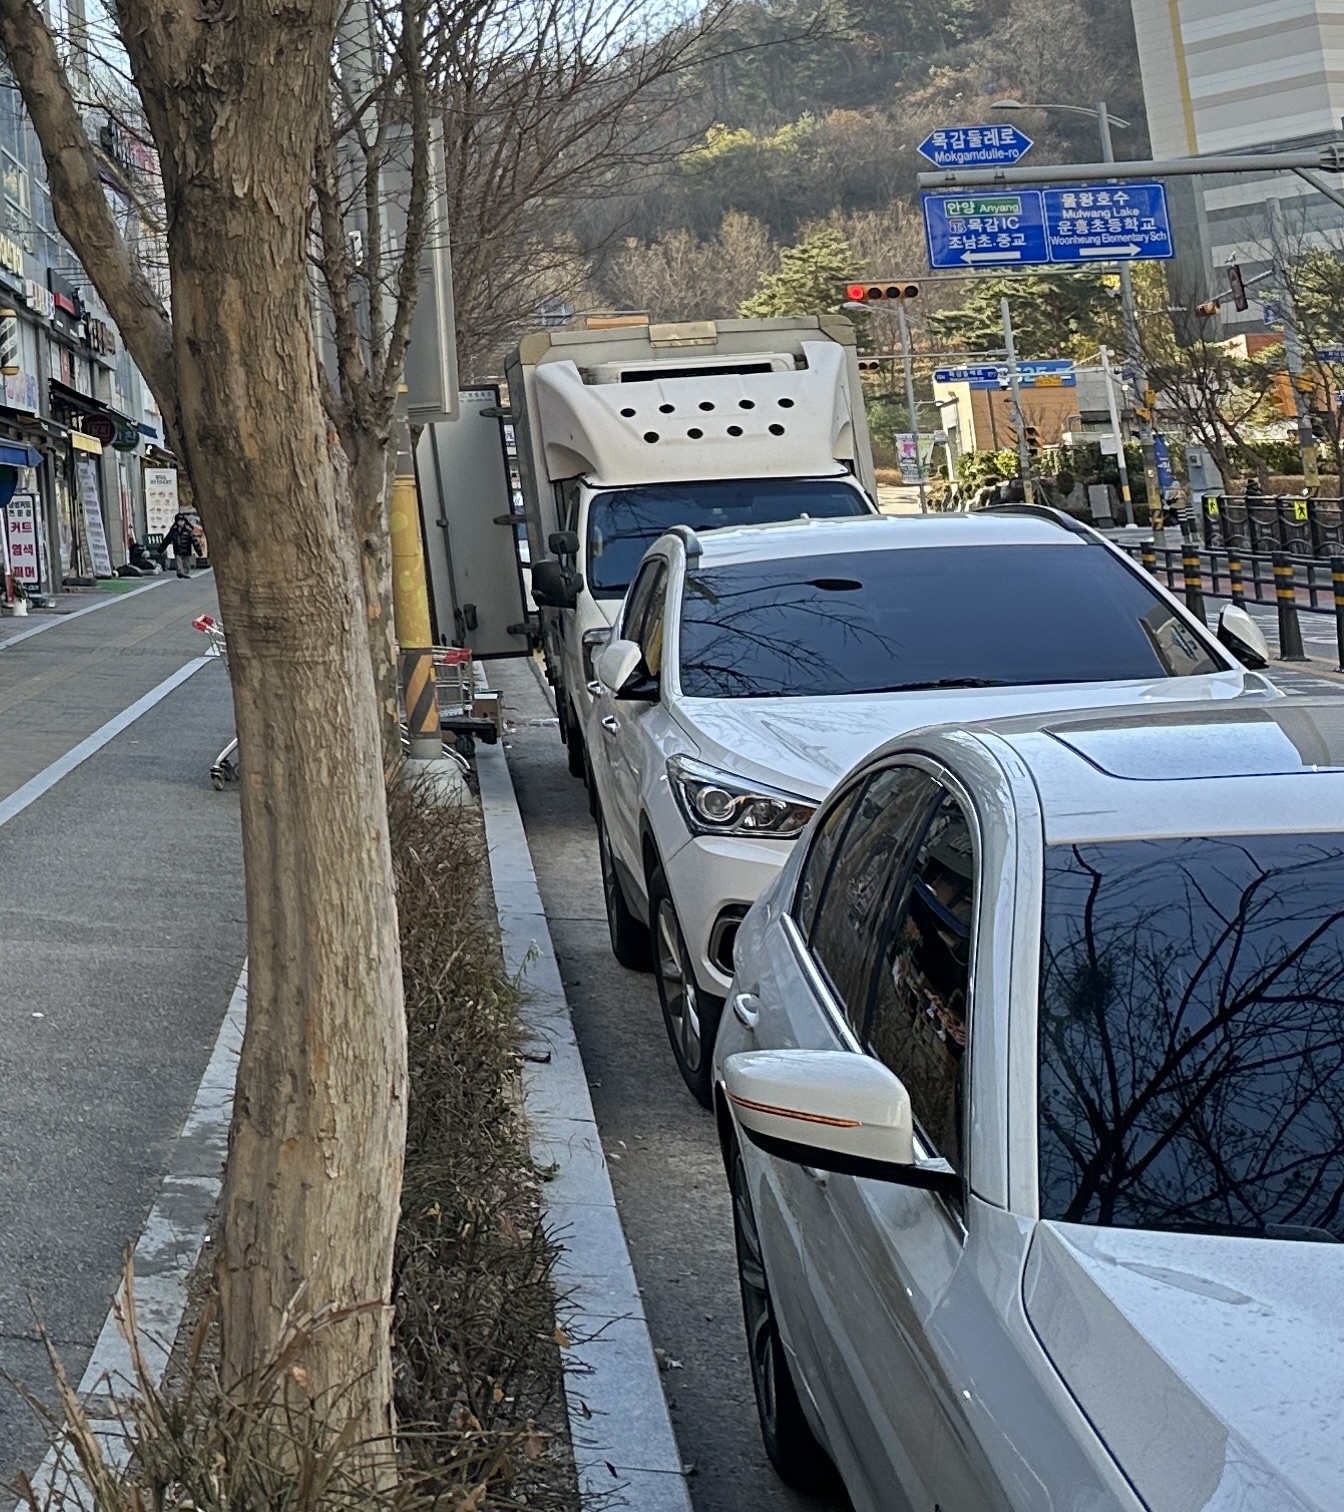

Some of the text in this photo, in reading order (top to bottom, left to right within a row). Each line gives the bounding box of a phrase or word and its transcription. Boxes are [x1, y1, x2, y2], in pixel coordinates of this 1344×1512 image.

[932, 128, 1017, 150] 목감둘레로
[934, 148, 1020, 163] Mokgamdulle-ro
[1062, 191, 1130, 208] 물왕호수
[947, 201, 1020, 215] 안양 Anyang
[1062, 207, 1140, 219] Mulwang Lake
[968, 217, 1020, 233] 목감IC
[1057, 218, 1157, 236] 운흥초등학교
